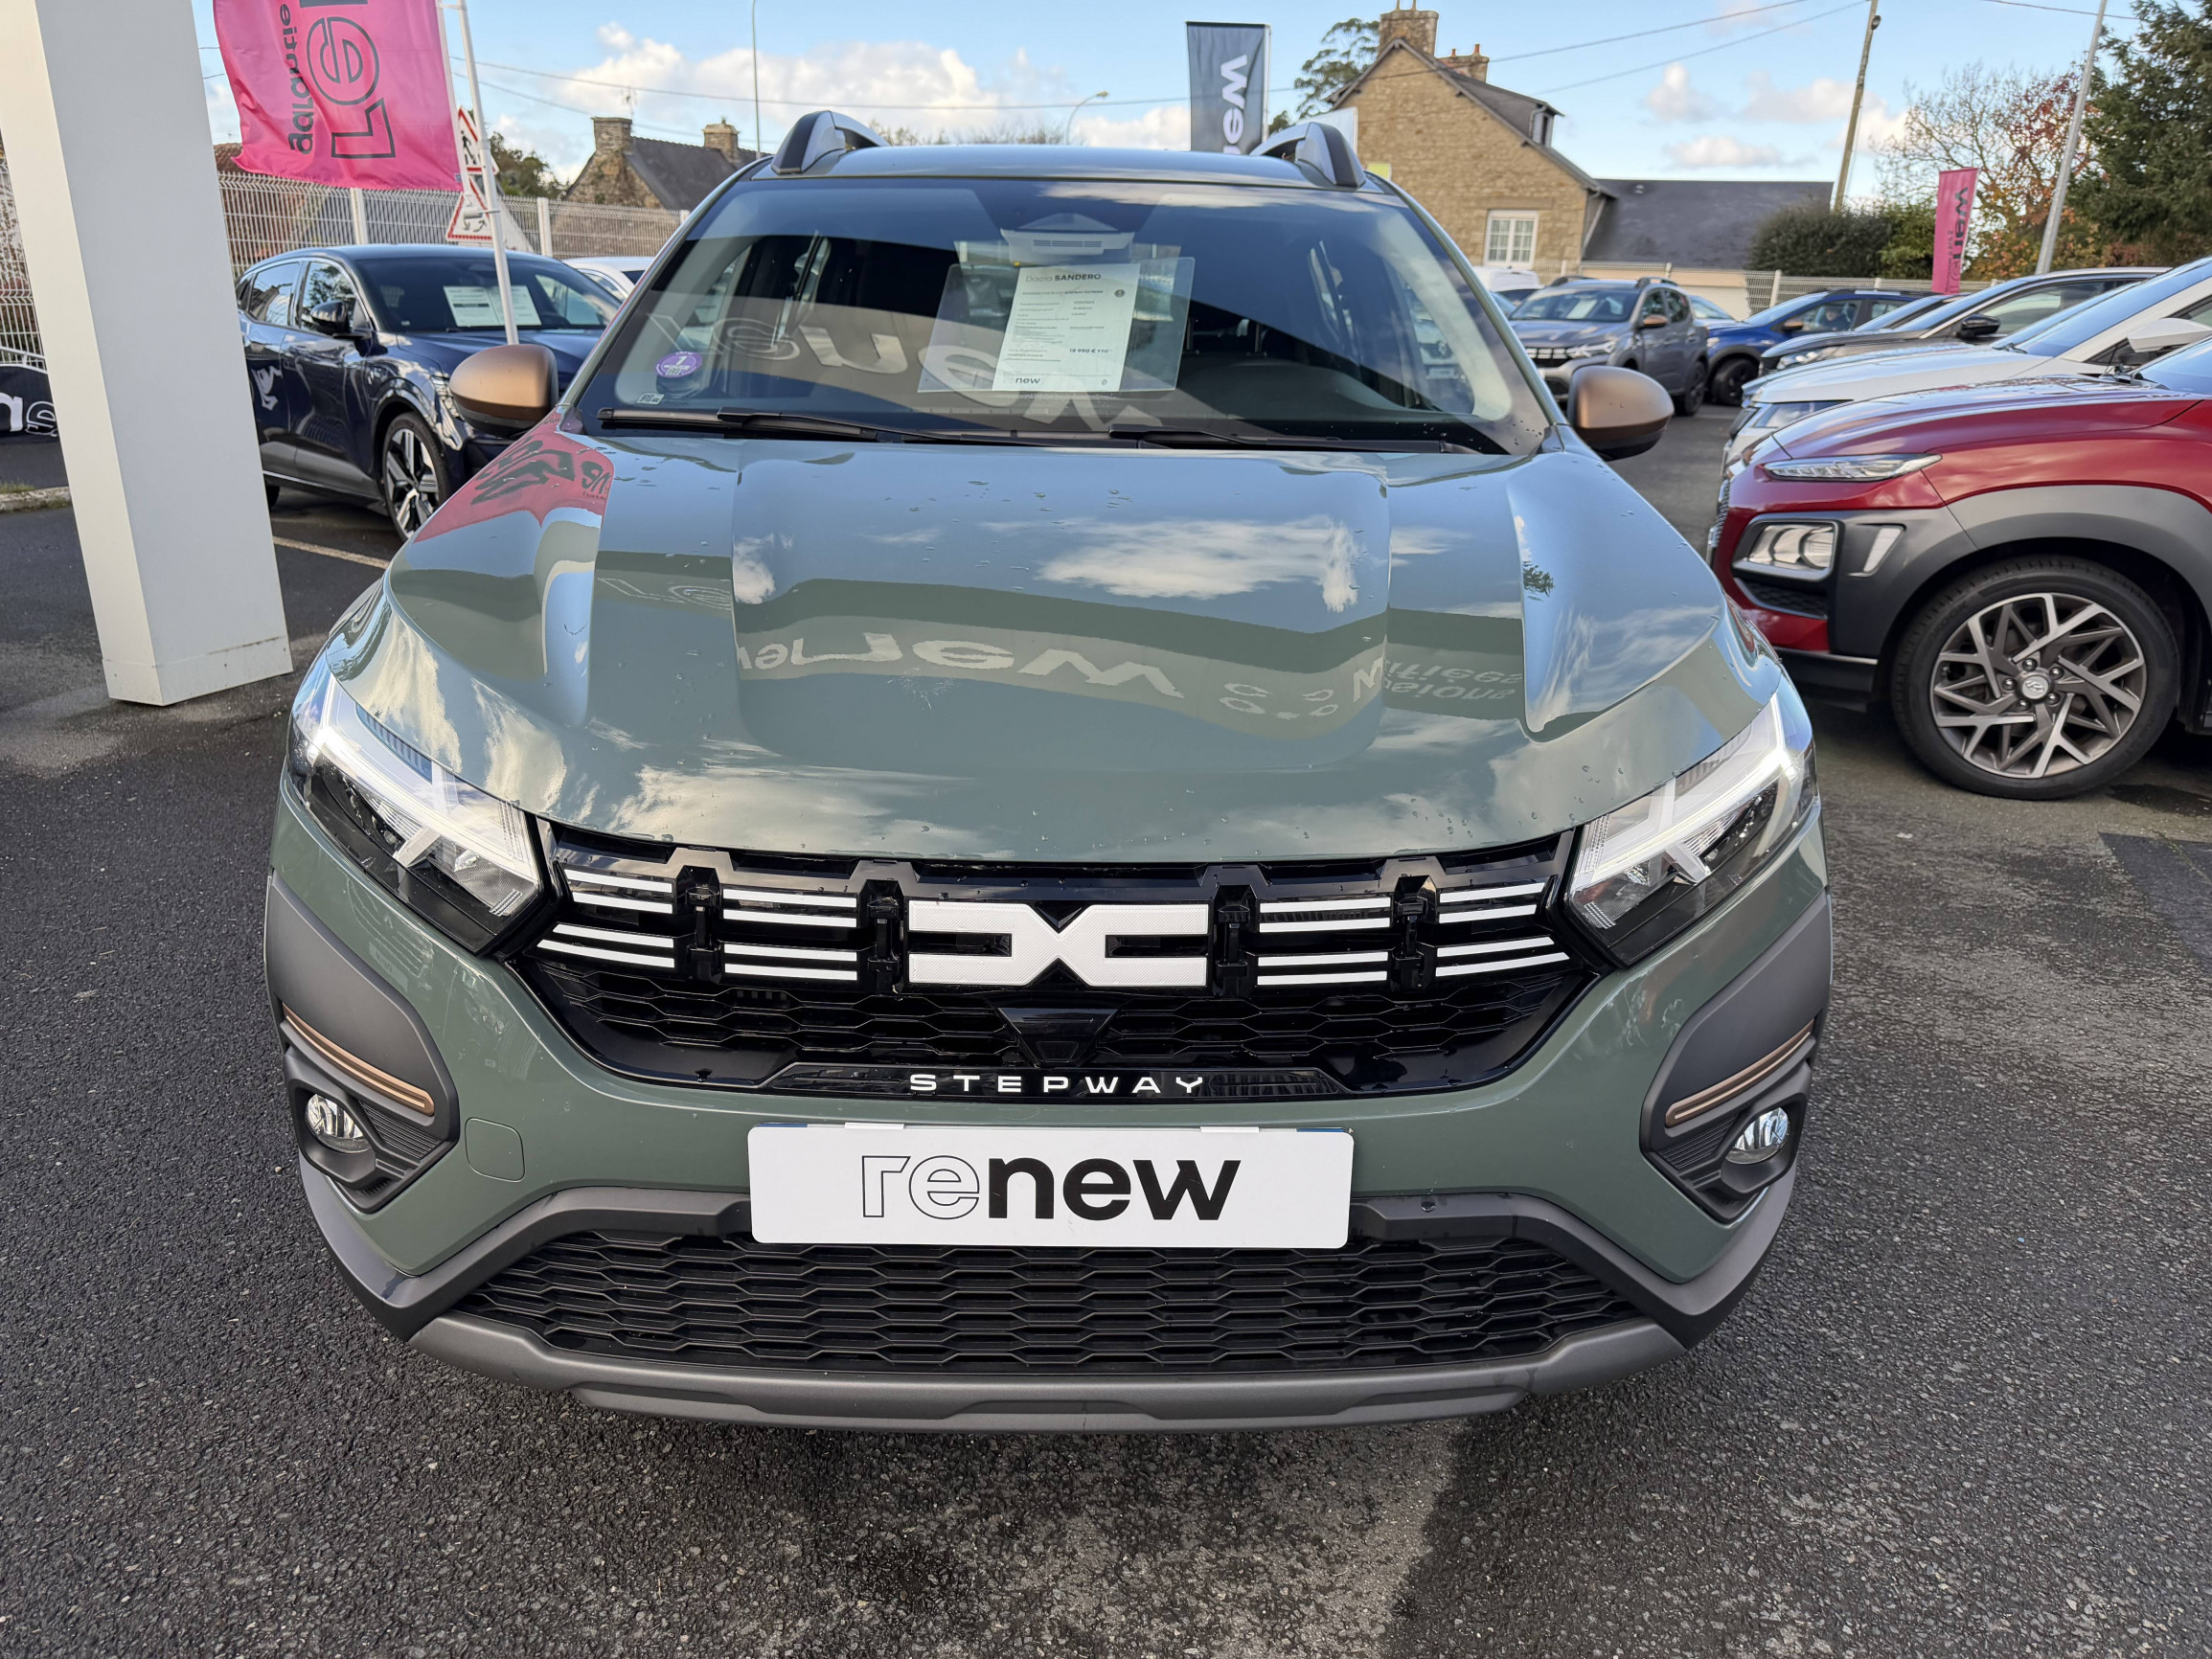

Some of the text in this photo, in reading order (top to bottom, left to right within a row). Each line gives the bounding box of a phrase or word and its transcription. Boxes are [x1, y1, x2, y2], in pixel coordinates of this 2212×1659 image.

[1054, 273, 1102, 282] SANDERO
[909, 1073, 1206, 1094] STEPWAY
[860, 1154, 1242, 1221] renew
